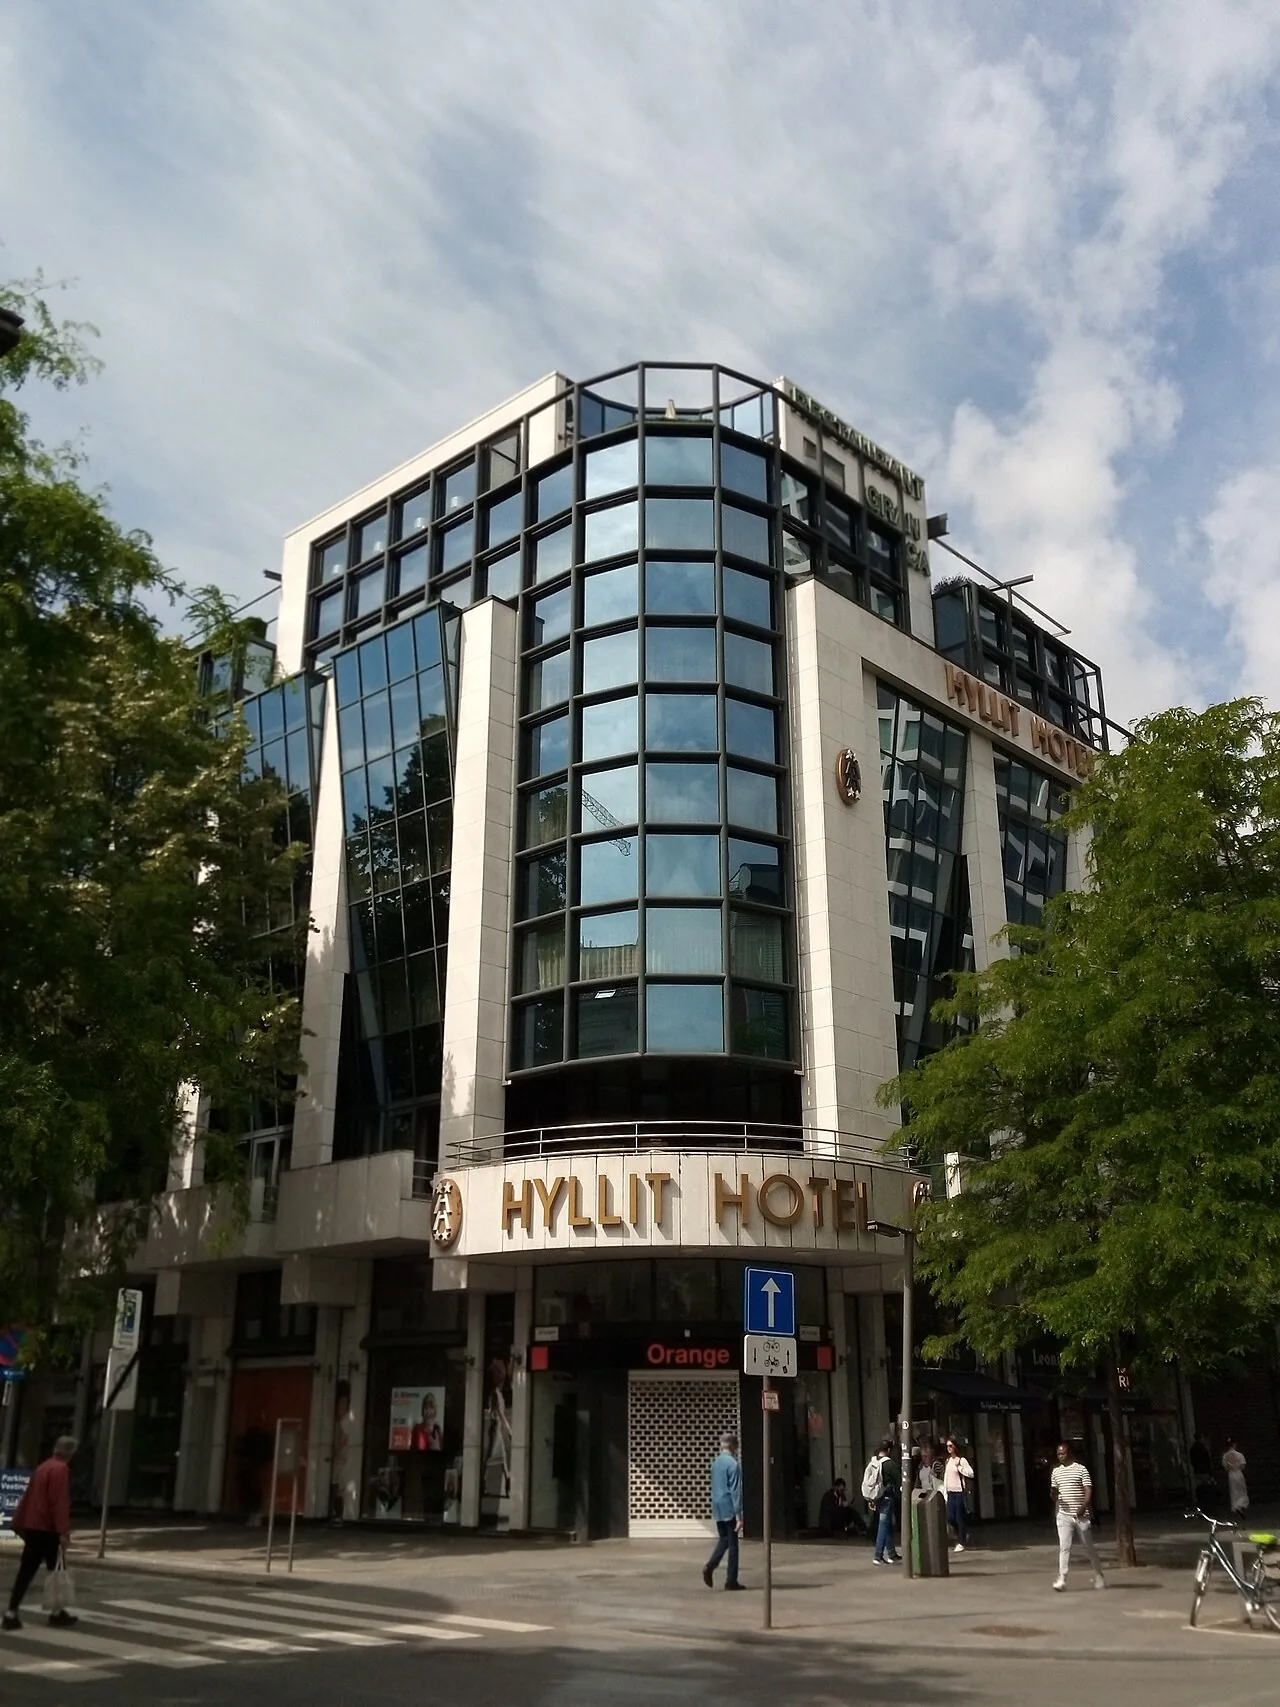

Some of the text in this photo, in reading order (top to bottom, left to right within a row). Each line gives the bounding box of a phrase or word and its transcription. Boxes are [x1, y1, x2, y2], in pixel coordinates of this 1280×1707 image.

[944, 663, 1020, 737] HYLLIT
[501, 1173, 868, 1231] HYLLIT HOTEL
[647, 1343, 730, 1369] Orange
[2, 1474, 30, 1484] Parking
